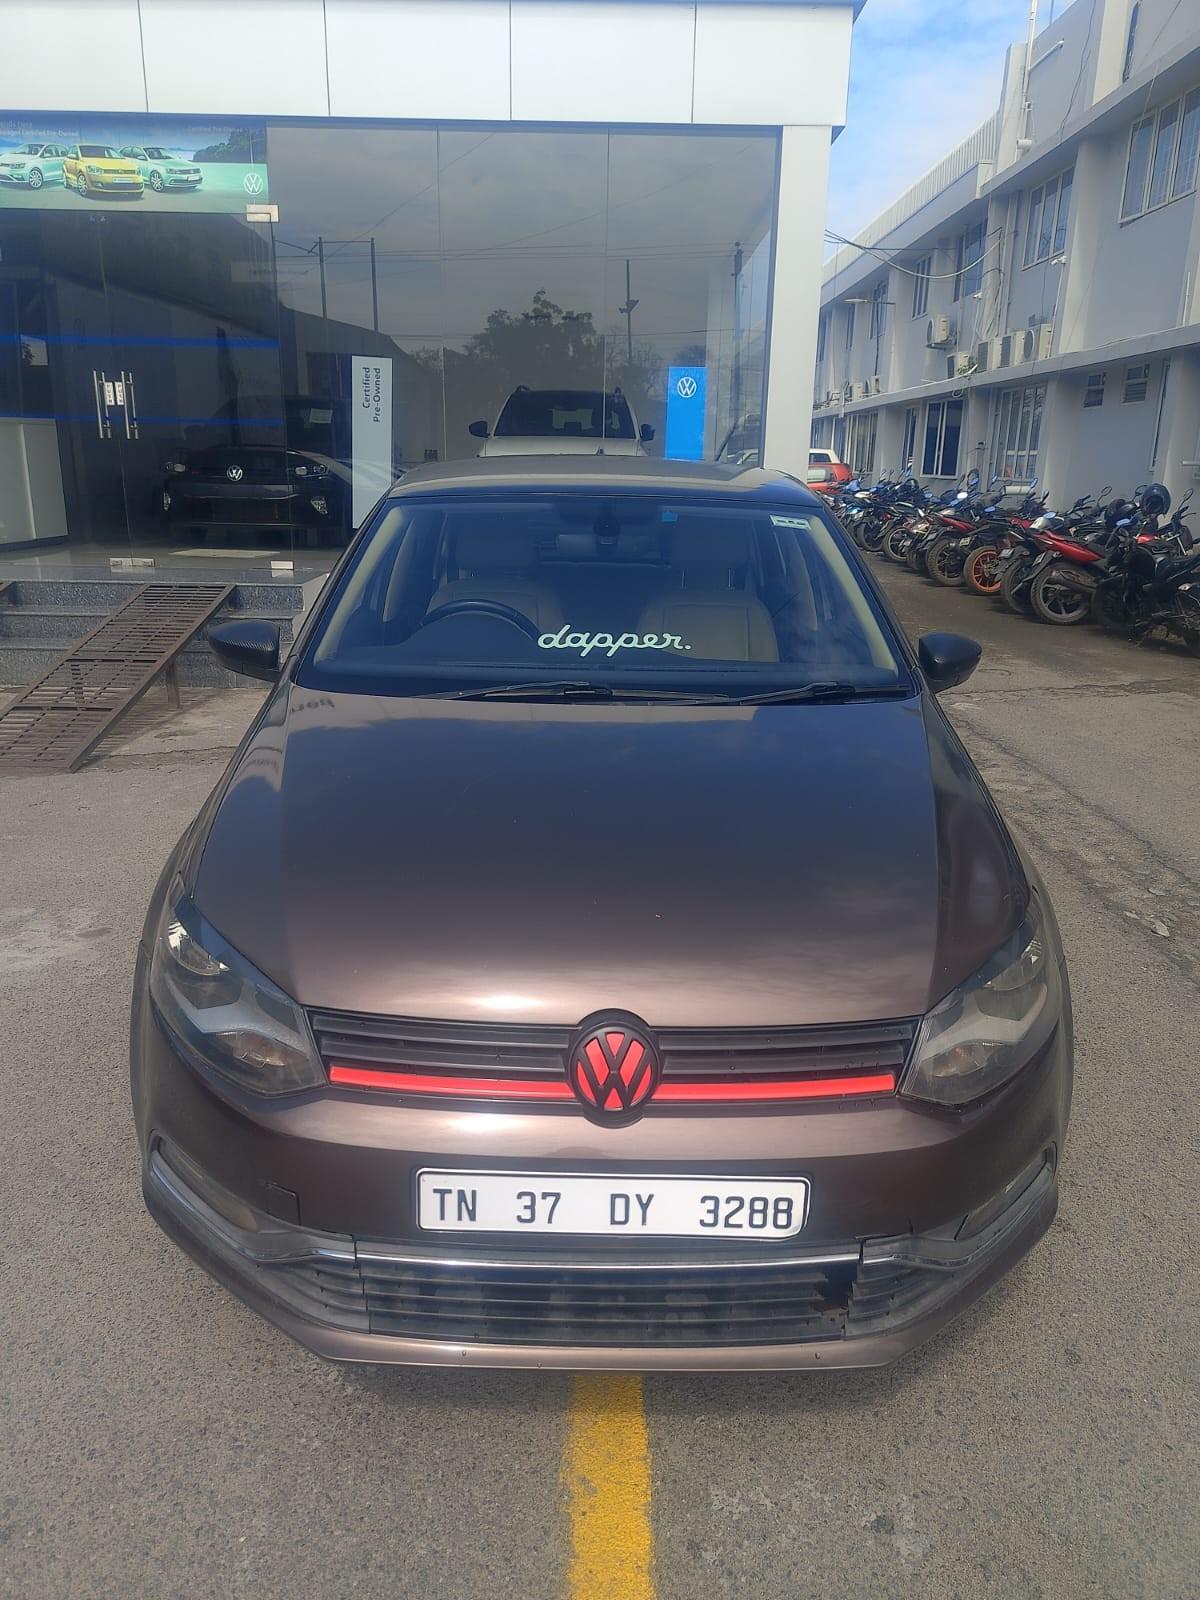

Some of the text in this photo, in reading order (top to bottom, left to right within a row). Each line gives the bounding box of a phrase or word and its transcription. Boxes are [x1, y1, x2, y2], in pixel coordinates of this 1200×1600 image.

[362, 367, 371, 409] Certified
[373, 368, 382, 422] Pre-Owned
[537, 624, 691, 656] dapper.
[433, 1188, 794, 1230] TN 37 DY 3288
